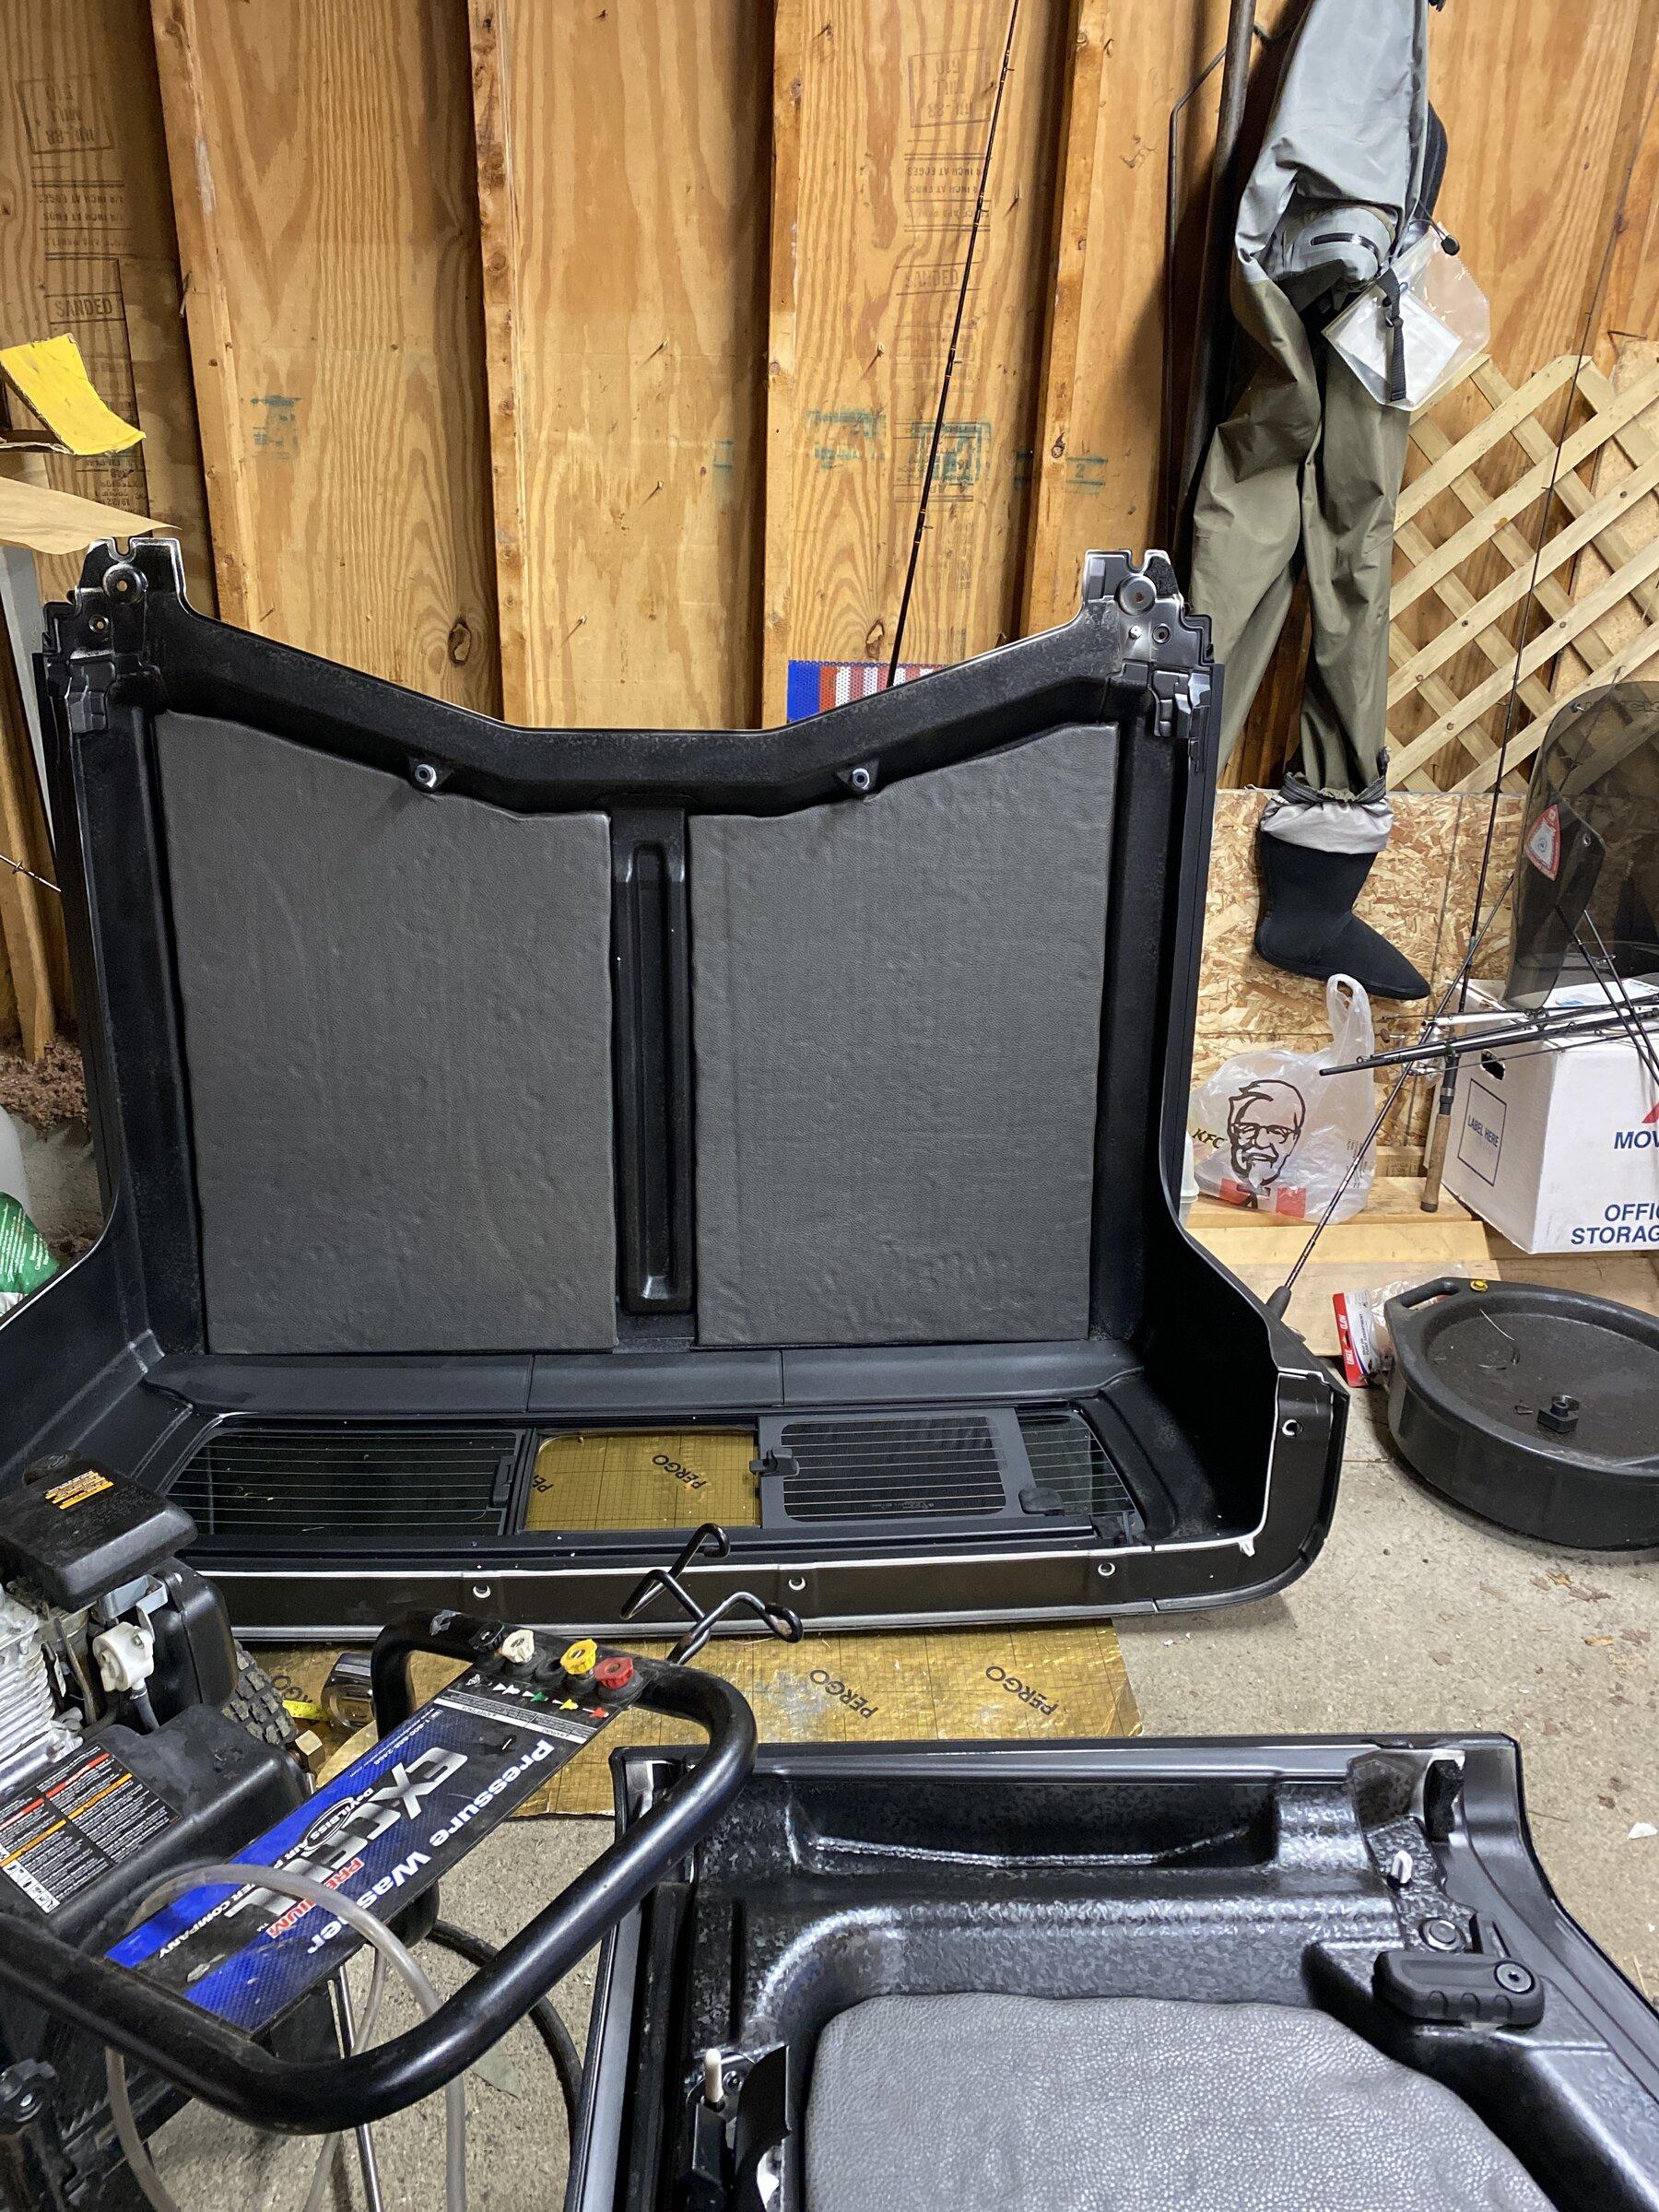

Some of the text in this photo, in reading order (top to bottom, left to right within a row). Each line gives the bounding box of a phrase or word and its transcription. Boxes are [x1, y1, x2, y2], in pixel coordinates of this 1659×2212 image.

[55, 298, 112, 318] SANDED
[1192, 1127, 1225, 1149] KFC
[1467, 1114, 1500, 1148] LABEL HERE
[1605, 1203, 1659, 1222] OFFI
[652, 1454, 707, 1489] PERGO
[809, 1669, 878, 1719] PERGO
[985, 1665, 1059, 1716] PERGO
[284, 1840, 309, 1860] AIR
[307, 1739, 555, 1954] Pressure Waser
[266, 1856, 365, 1939] PREIUM
[159, 1900, 231, 1959] COMPANY
